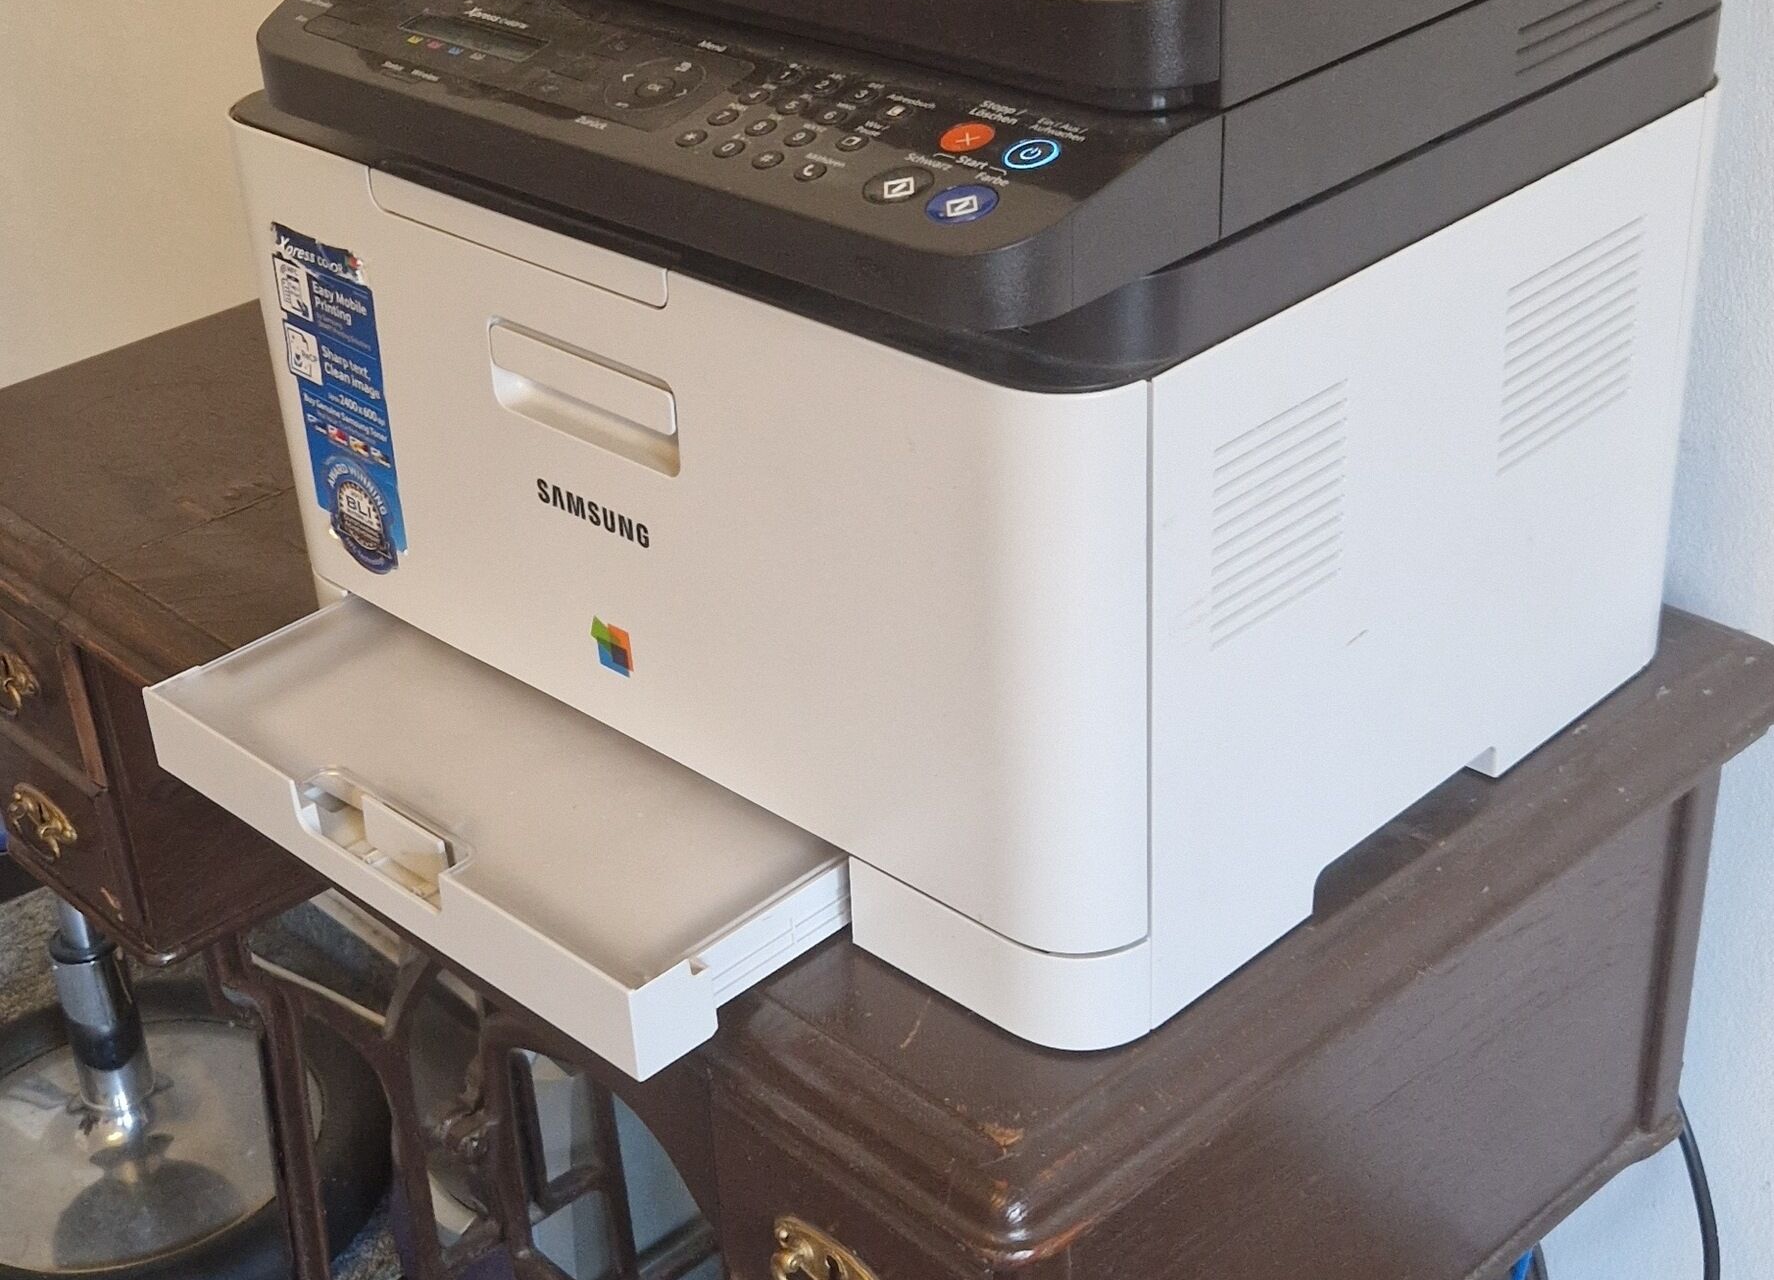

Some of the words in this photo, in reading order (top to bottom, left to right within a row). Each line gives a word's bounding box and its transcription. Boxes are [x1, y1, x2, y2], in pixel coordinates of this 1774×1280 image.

[854, 89, 869, 99] 3
[823, 111, 838, 120] 6
[968, 107, 1019, 126] Löschen
[980, 99, 1017, 116] Stopp
[791, 131, 807, 141] 9
[955, 154, 989, 171] Start
[974, 171, 1010, 187] Farbe
[312, 281, 334, 304] Easy
[335, 290, 368, 317] Mobile
[314, 296, 353, 326] Printing
[321, 344, 350, 370] Sharp
[324, 362, 351, 385] Clean
[350, 373, 382, 400] image
[349, 464, 388, 516] WINNING
[346, 496, 373, 519] BLI
[536, 477, 650, 549] SAMSUNG
